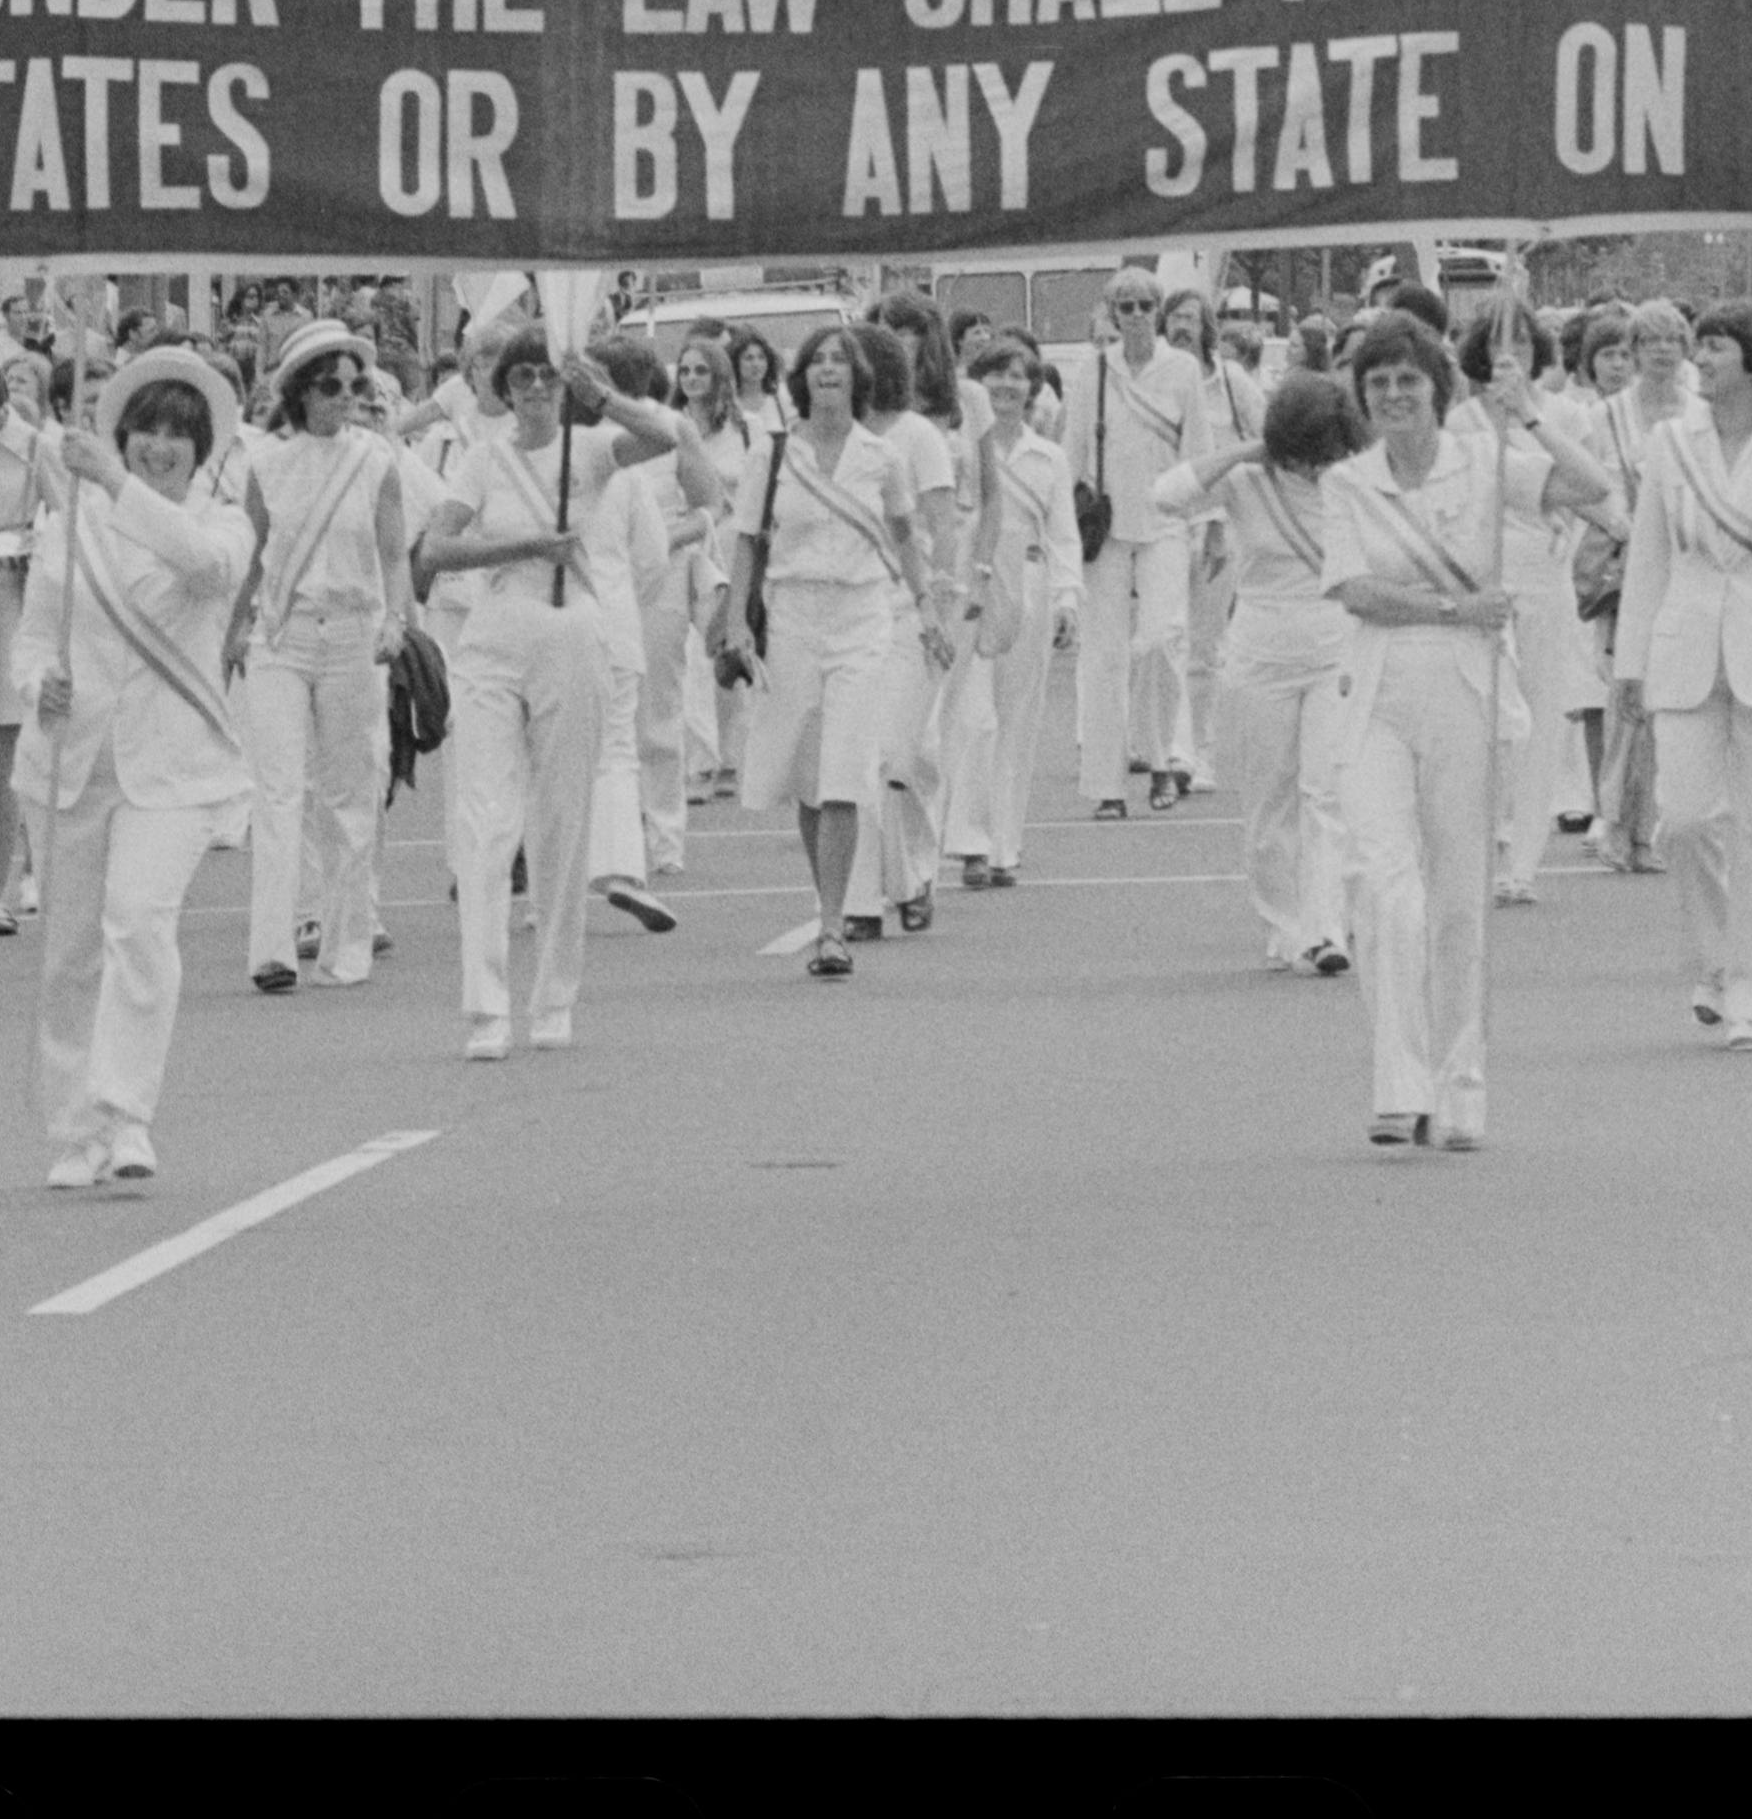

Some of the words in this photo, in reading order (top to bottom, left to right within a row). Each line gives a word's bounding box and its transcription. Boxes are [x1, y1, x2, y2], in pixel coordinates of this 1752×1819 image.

[379, 69, 518, 218] OR
[614, 71, 760, 219] BY
[844, 62, 1053, 215] ANY
[1146, 32, 1459, 196] STATE
[1556, 22, 1685, 174] ON
